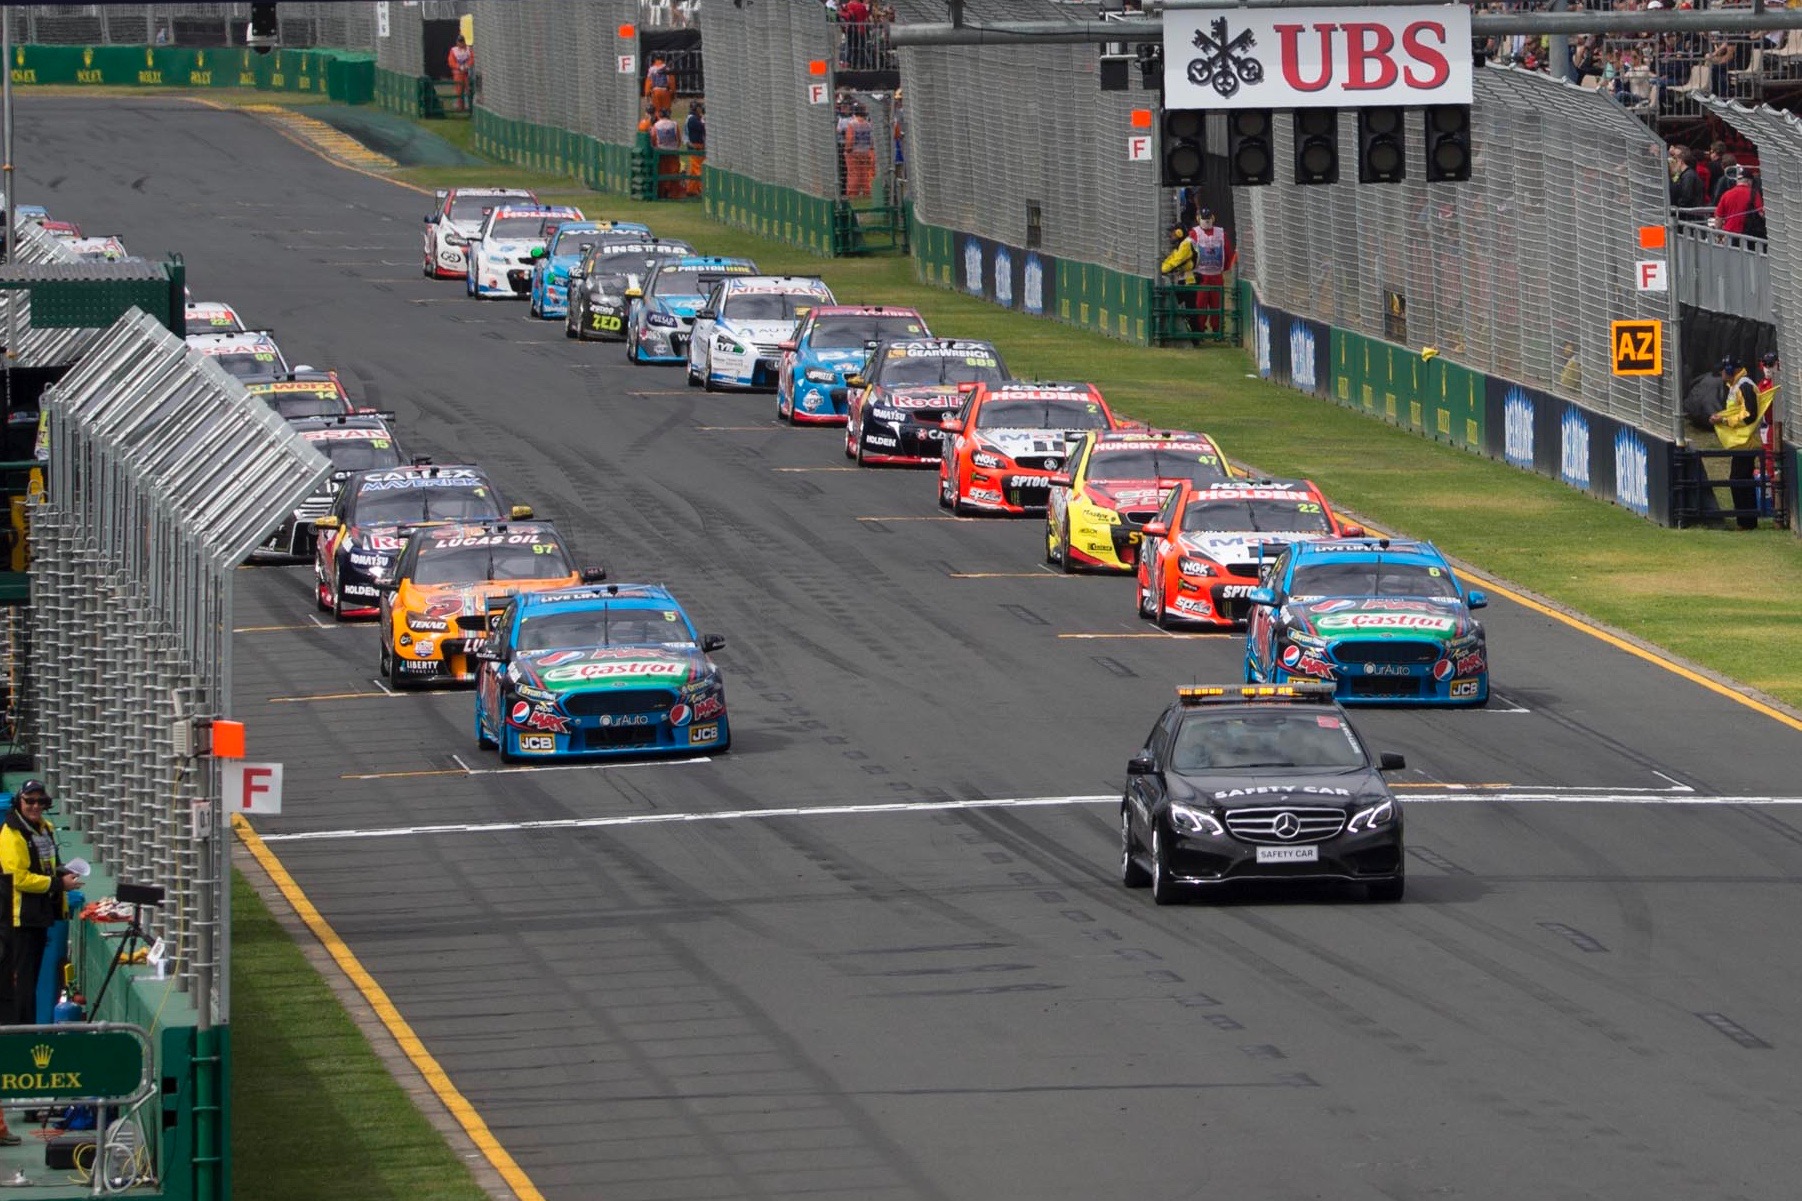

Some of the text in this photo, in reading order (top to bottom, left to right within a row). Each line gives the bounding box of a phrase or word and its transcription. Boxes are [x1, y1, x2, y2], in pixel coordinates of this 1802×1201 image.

[1273, 21, 1450, 92] UBS
[621, 57, 631, 71] F
[812, 86, 823, 102] F
[1133, 139, 1145, 158] F
[603, 244, 688, 255] INSTRA
[1641, 264, 1657, 288] F
[729, 286, 827, 296] NISSAN
[592, 314, 622, 331] ZED
[1617, 332, 1654, 361] AZ
[907, 349, 989, 359] GEARWRENCH
[316, 391, 338, 400] 14
[991, 392, 1089, 400] HOLDEN
[1086, 405, 1097, 413] 2
[370, 439, 389, 449] 15
[866, 435, 896, 448] HOLDEN
[1094, 442, 1213, 451] HUNGRY JACKS
[975, 453, 998, 466] NGK
[362, 478, 482, 492] MAVERICK
[474, 488, 485, 497] 1
[1199, 490, 1310, 500] HOLDEN
[1297, 503, 1320, 513] 22
[435, 535, 540, 548] LUCAS OIL
[532, 544, 553, 554] 97
[1183, 561, 1209, 574] NGK
[1428, 566, 1441, 577] 6
[345, 584, 380, 597] HOLDEN
[663, 611, 676, 622] 5
[1351, 614, 1445, 629] Castrol
[409, 620, 447, 629] TEKNO
[406, 661, 438, 669] LIBERTY
[580, 663, 677, 677] Castrol
[1364, 661, 1411, 676] OurAuto
[1453, 682, 1478, 696] JCB
[599, 714, 649, 727] OurAuto
[692, 727, 718, 741] JCB
[521, 736, 553, 749] JCB
[242, 768, 272, 808] F
[1215, 785, 1350, 799] SAFETY CAR
[1260, 849, 1313, 860] SAFETY CAR
[1, 1072, 83, 1090] ROLEX
